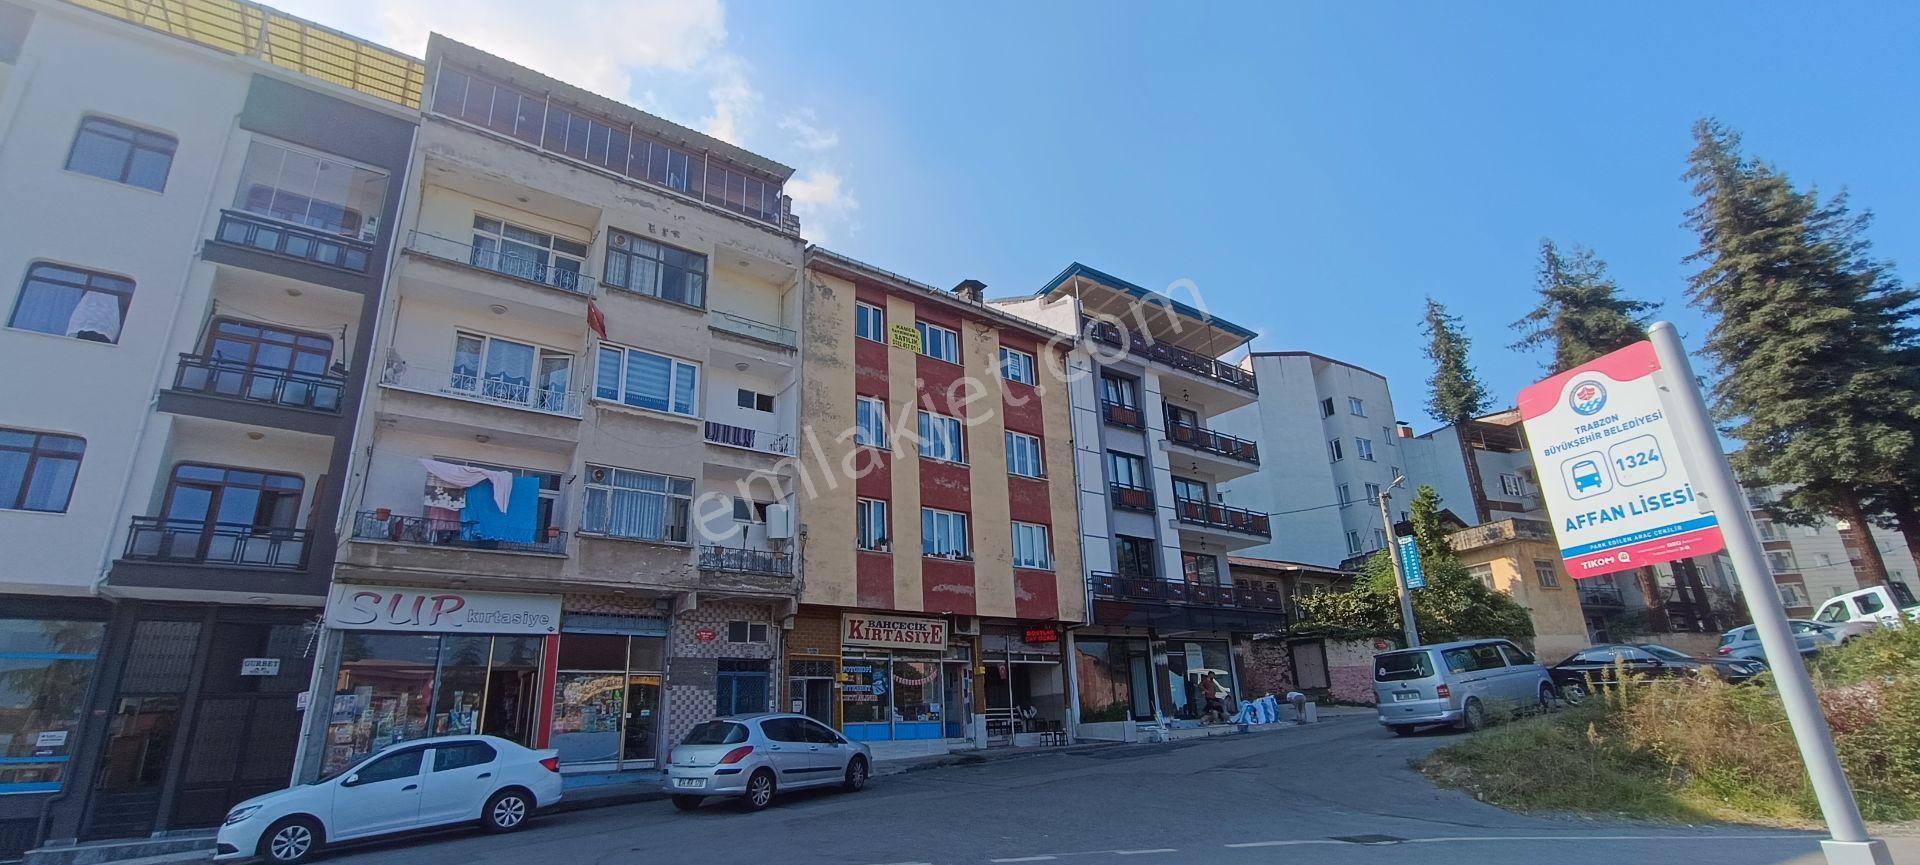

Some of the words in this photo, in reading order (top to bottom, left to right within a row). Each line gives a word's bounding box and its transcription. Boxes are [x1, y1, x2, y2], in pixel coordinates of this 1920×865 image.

[1544, 431, 1602, 456] BÜYÜKŞEHİR
[1604, 409, 1663, 437] BELEDİYESİ
[1574, 414, 1619, 434] TRABZON
[1616, 449, 1659, 471] 1324
[1565, 504, 1625, 532] AFFAN
[1628, 483, 1695, 516] LİSESİ
[337, 591, 465, 627] SUR
[467, 609, 550, 627] kırtasiye
[848, 619, 942, 645] KIRTASİYE
[867, 620, 928, 632] BAHÇECİK
